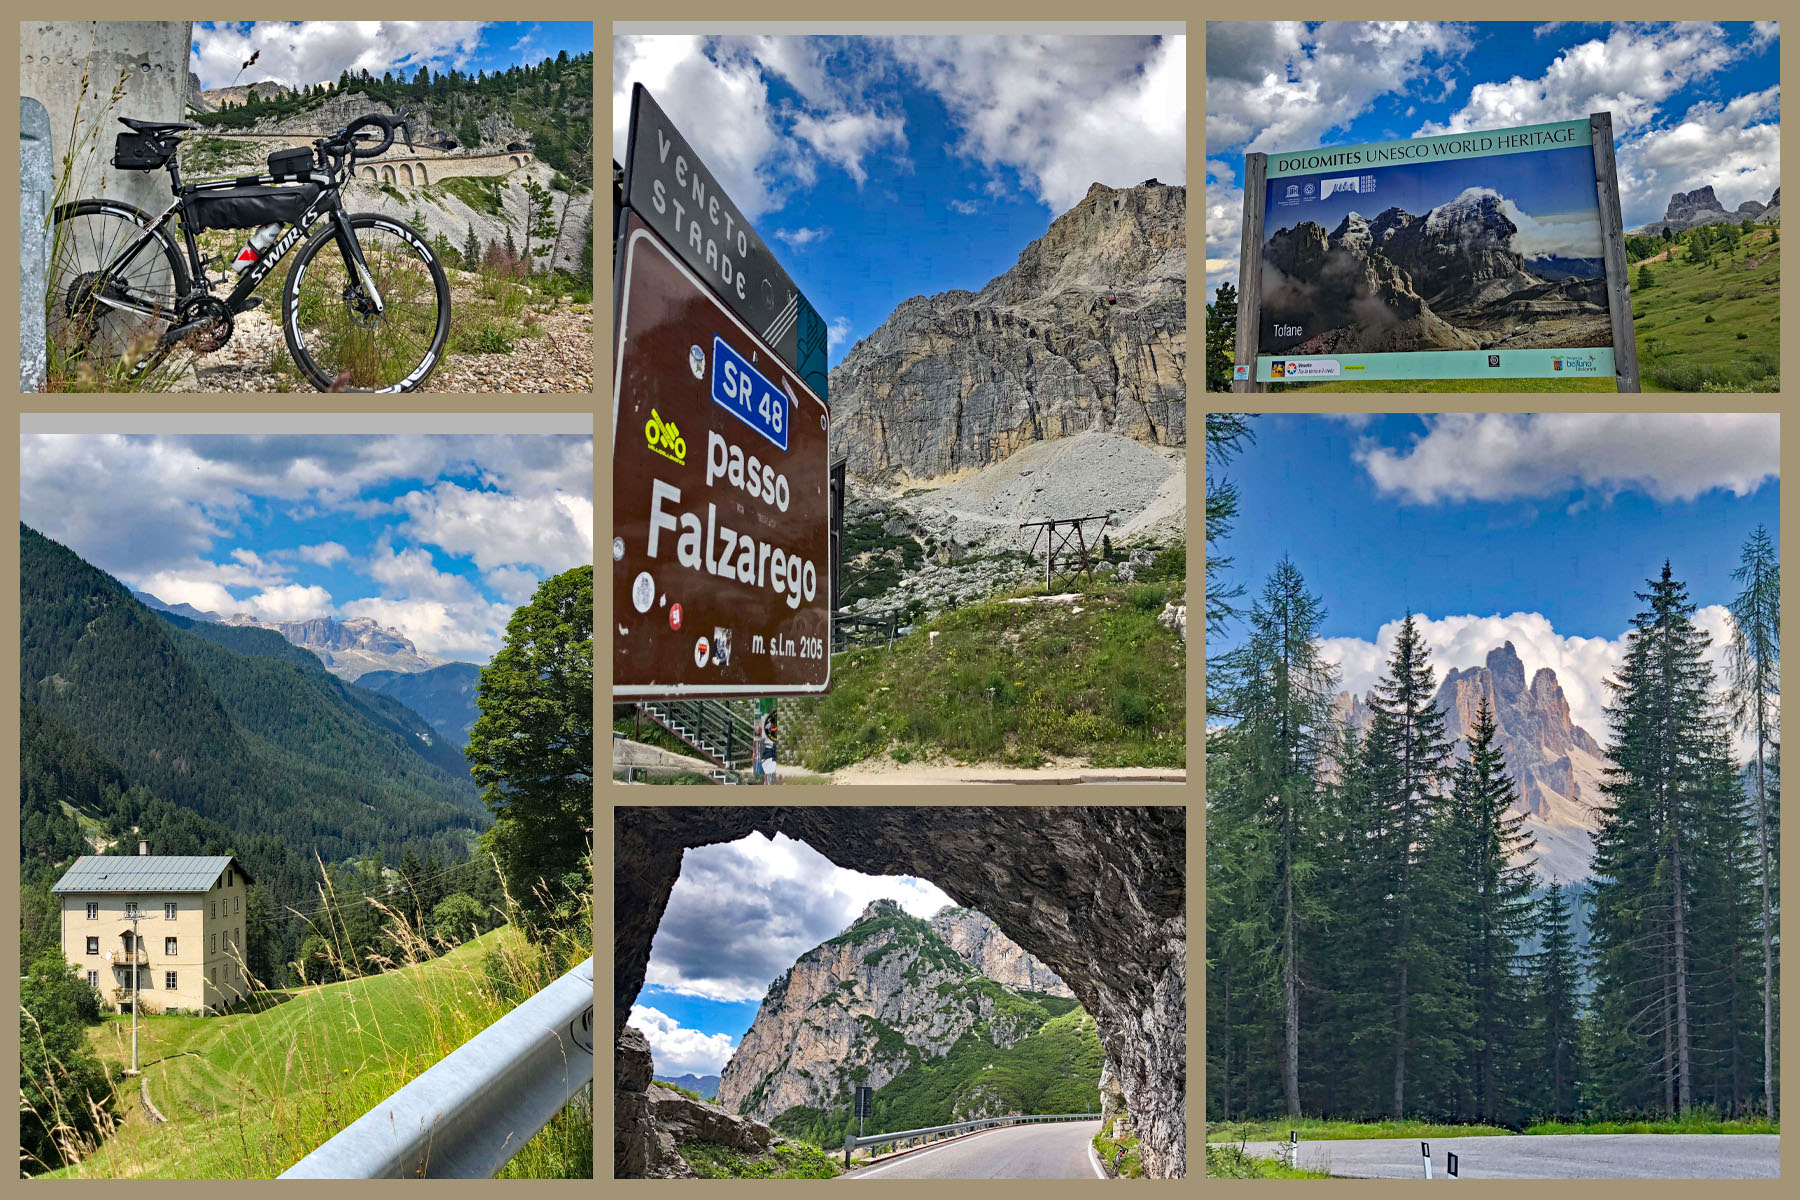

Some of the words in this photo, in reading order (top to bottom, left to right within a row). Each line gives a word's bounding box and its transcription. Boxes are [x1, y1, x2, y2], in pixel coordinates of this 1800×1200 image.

[1279, 151, 1361, 173] DOLOMITES
[1366, 144, 1430, 164] UNESCO
[1432, 137, 1493, 157] WORLD
[1498, 128, 1576, 149] HERITAGE
[657, 129, 748, 259] VENETO
[652, 179, 746, 301] STRADE
[1273, 324, 1302, 337] Tofane
[723, 361, 752, 412] SR
[758, 392, 783, 434] 48
[706, 429, 790, 513] passo
[647, 478, 817, 610] Falzarego
[752, 633, 765, 655] m.
[800, 635, 823, 659] 2105
